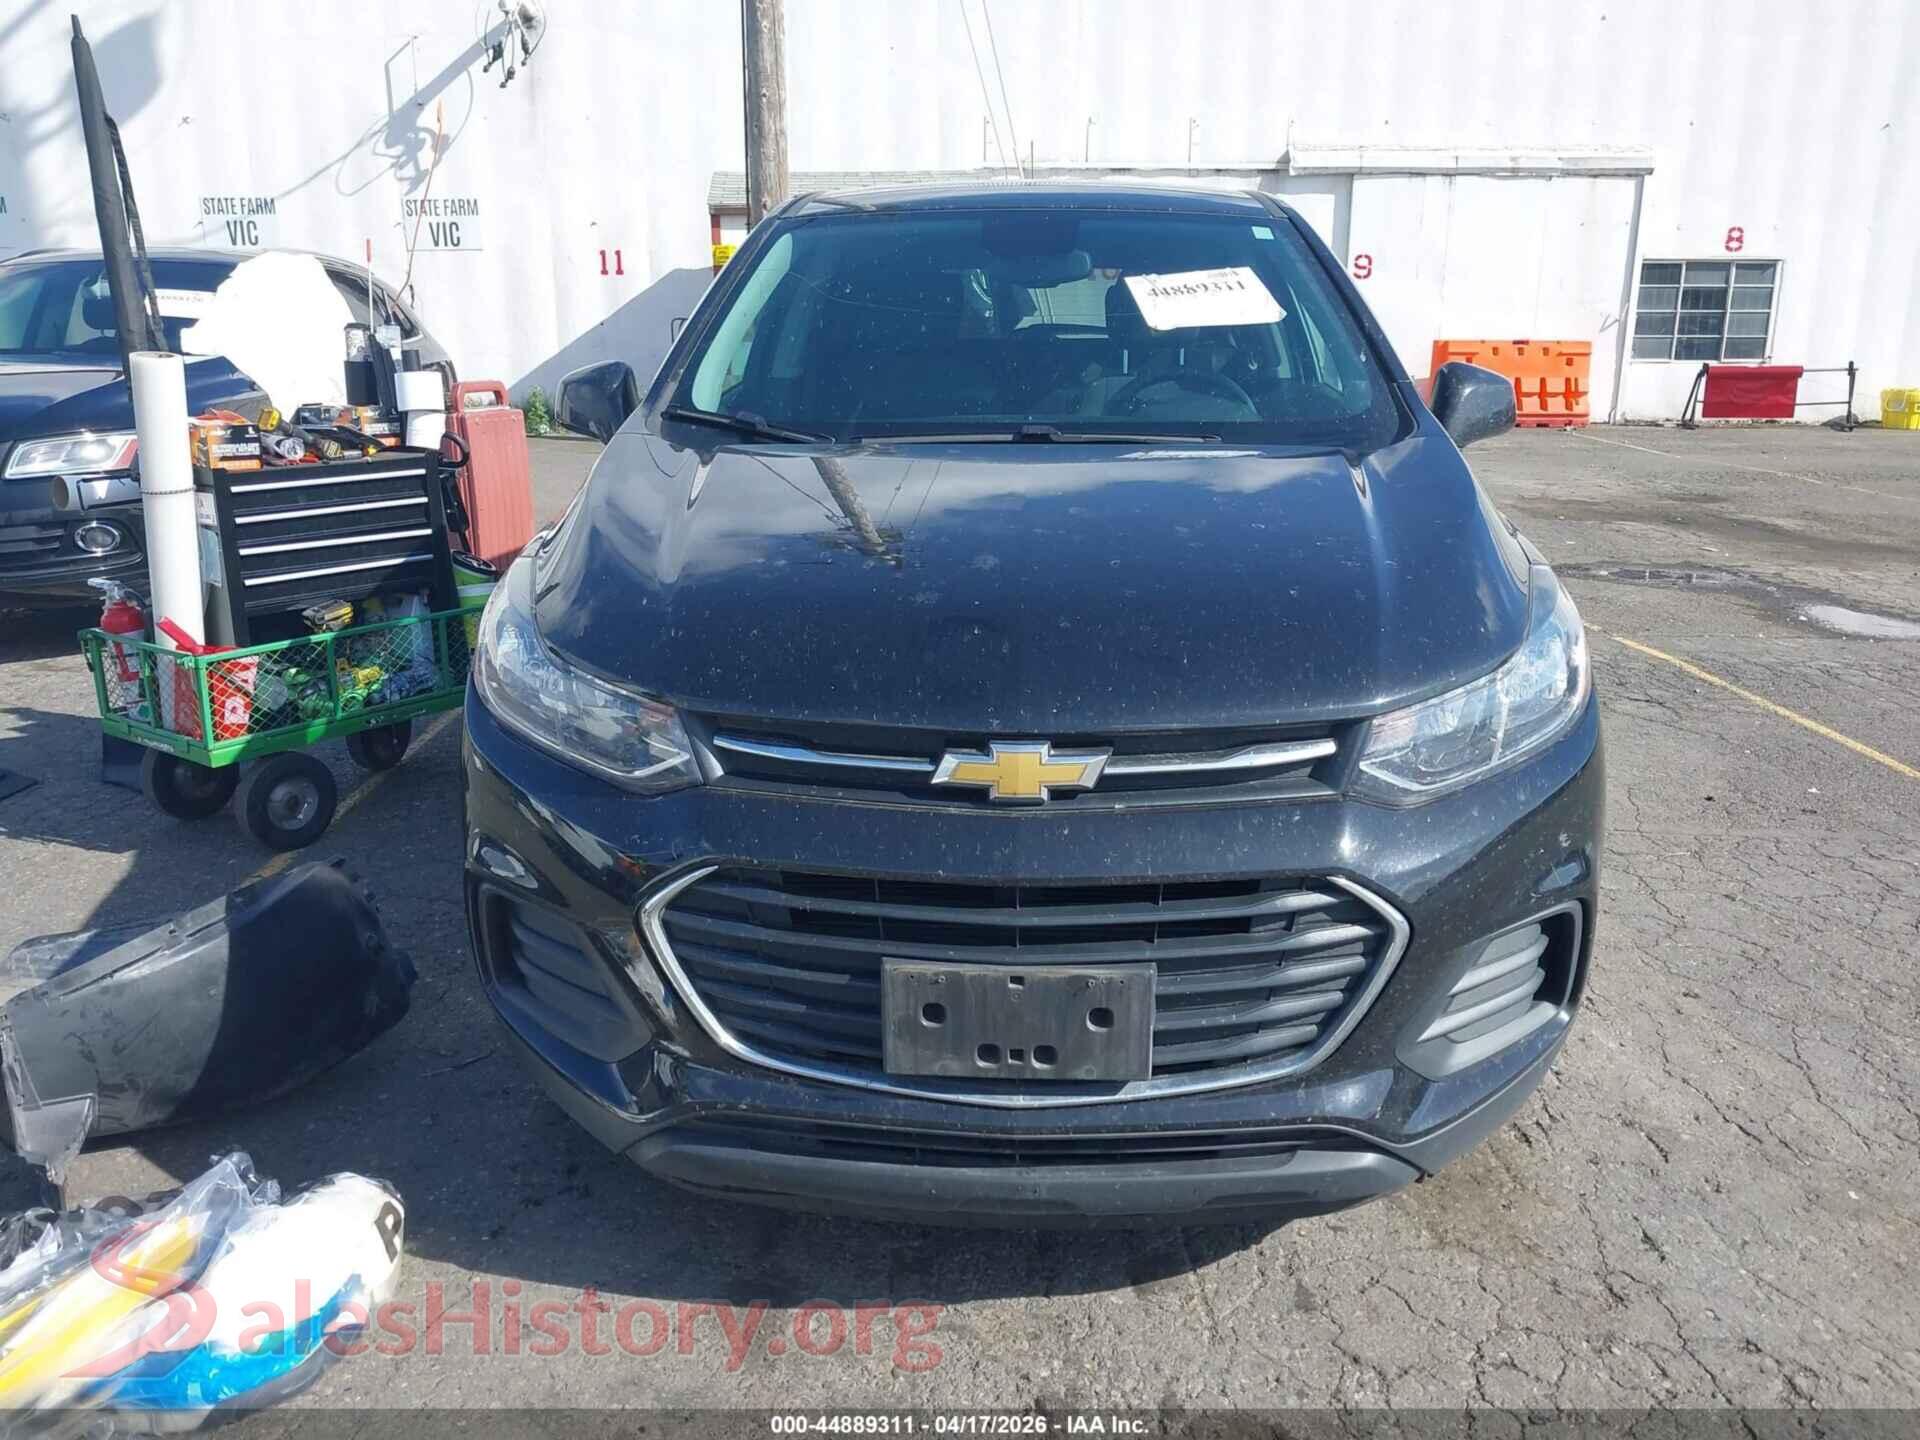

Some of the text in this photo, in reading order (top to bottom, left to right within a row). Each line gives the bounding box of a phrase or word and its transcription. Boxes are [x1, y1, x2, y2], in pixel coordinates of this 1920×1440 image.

[203, 197, 276, 215] STATE FARM
[405, 198, 479, 217] STATE FARM
[226, 220, 259, 246] VIC
[428, 221, 461, 247] VIC
[1724, 226, 1745, 252] 8
[599, 250, 624, 275] 11
[1352, 253, 1374, 280] 9
